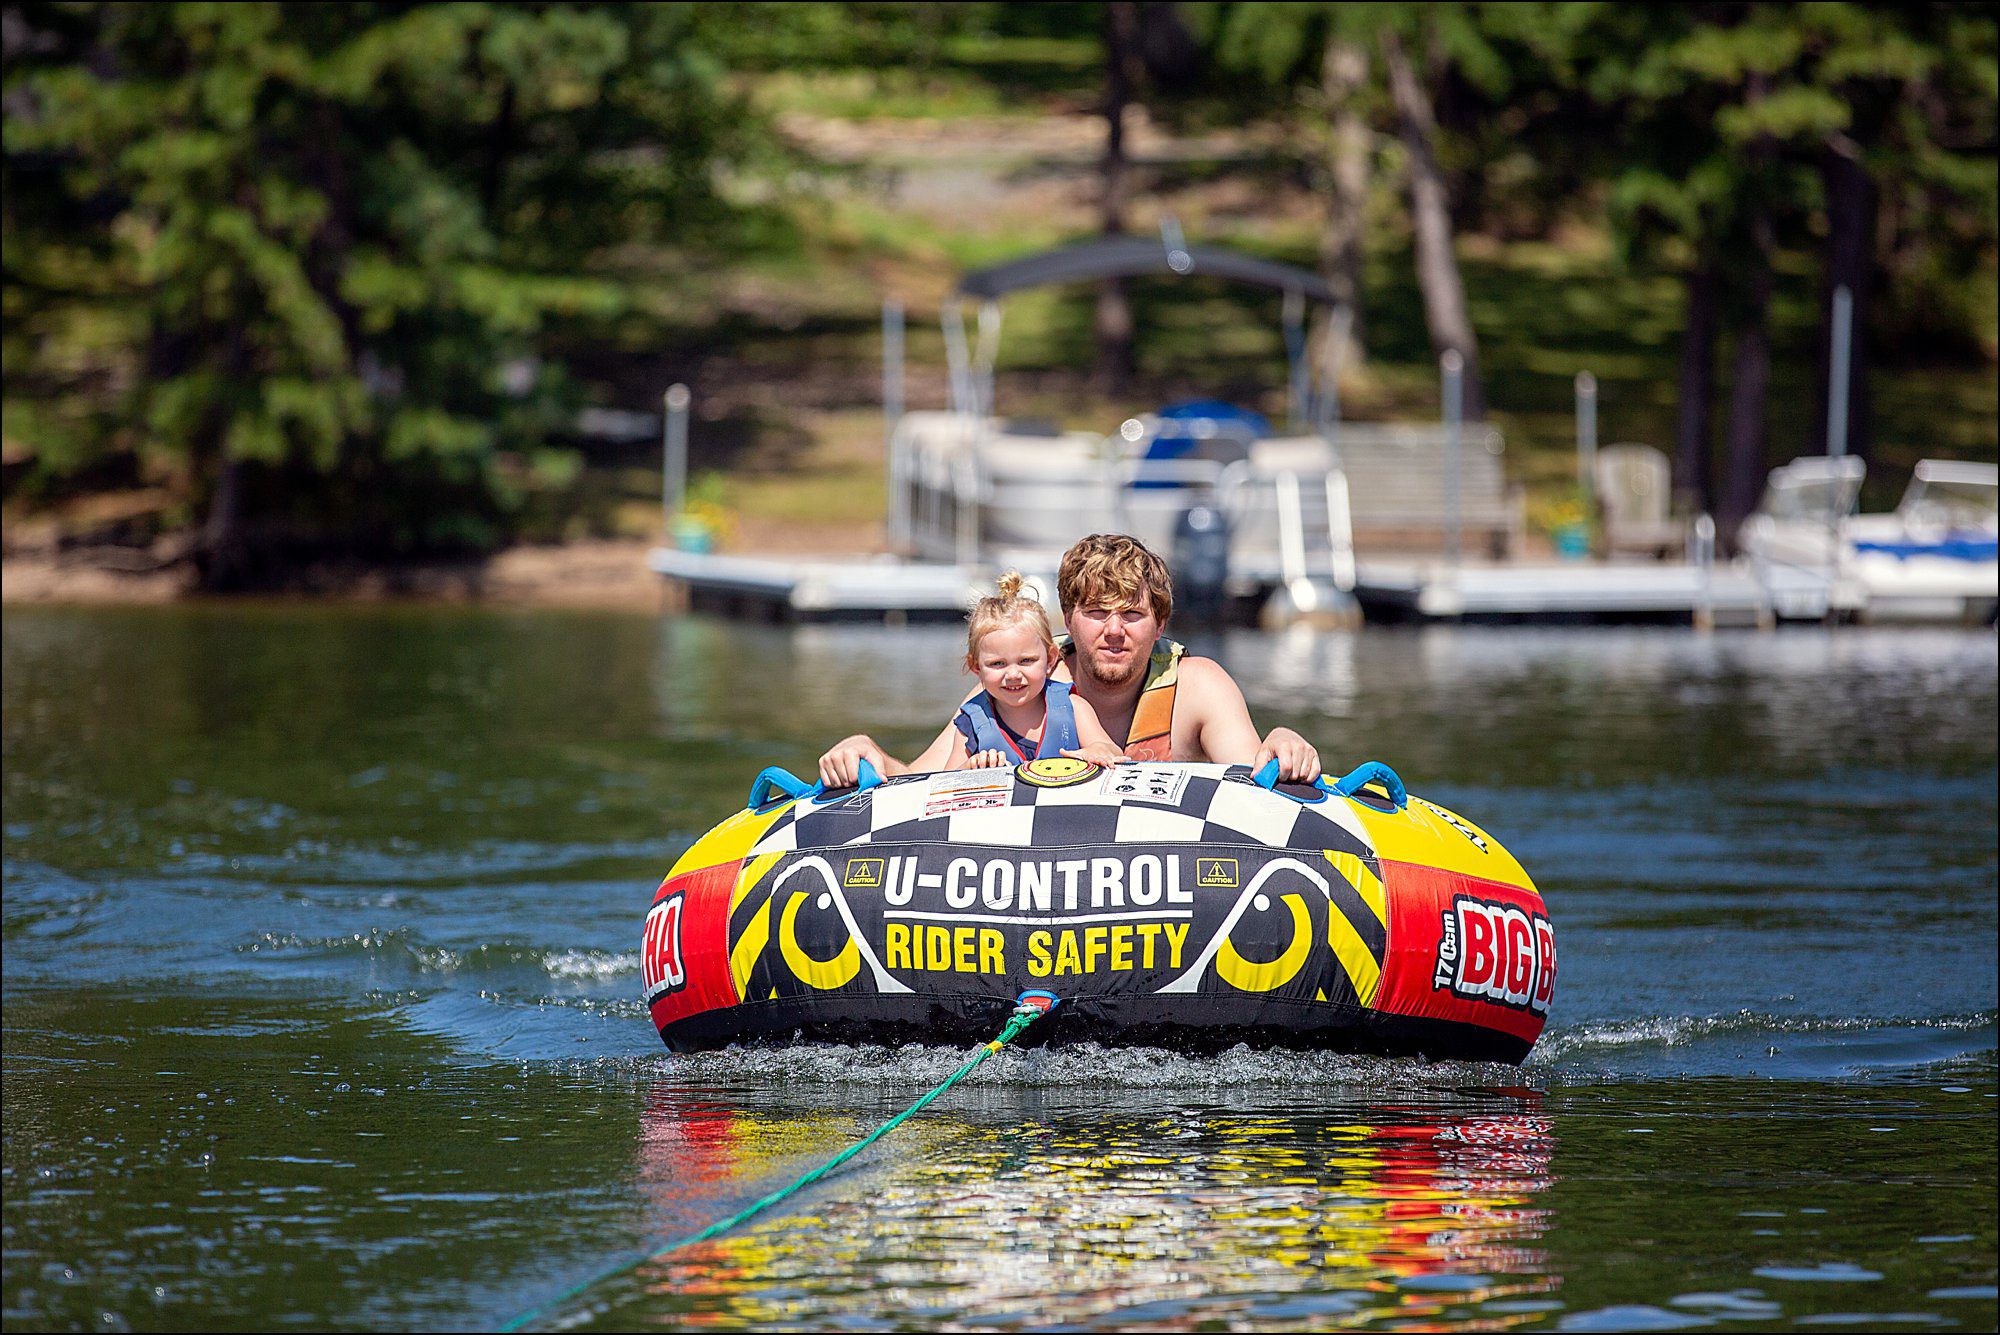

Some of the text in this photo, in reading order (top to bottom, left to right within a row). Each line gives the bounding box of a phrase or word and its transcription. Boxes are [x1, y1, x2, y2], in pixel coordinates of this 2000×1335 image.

[884, 854, 1194, 911] U-CONTROL
[886, 923, 1191, 978] RIDER SAFETY
[1434, 913, 1457, 989] 170cm
[1455, 900, 1537, 1005] BIG
